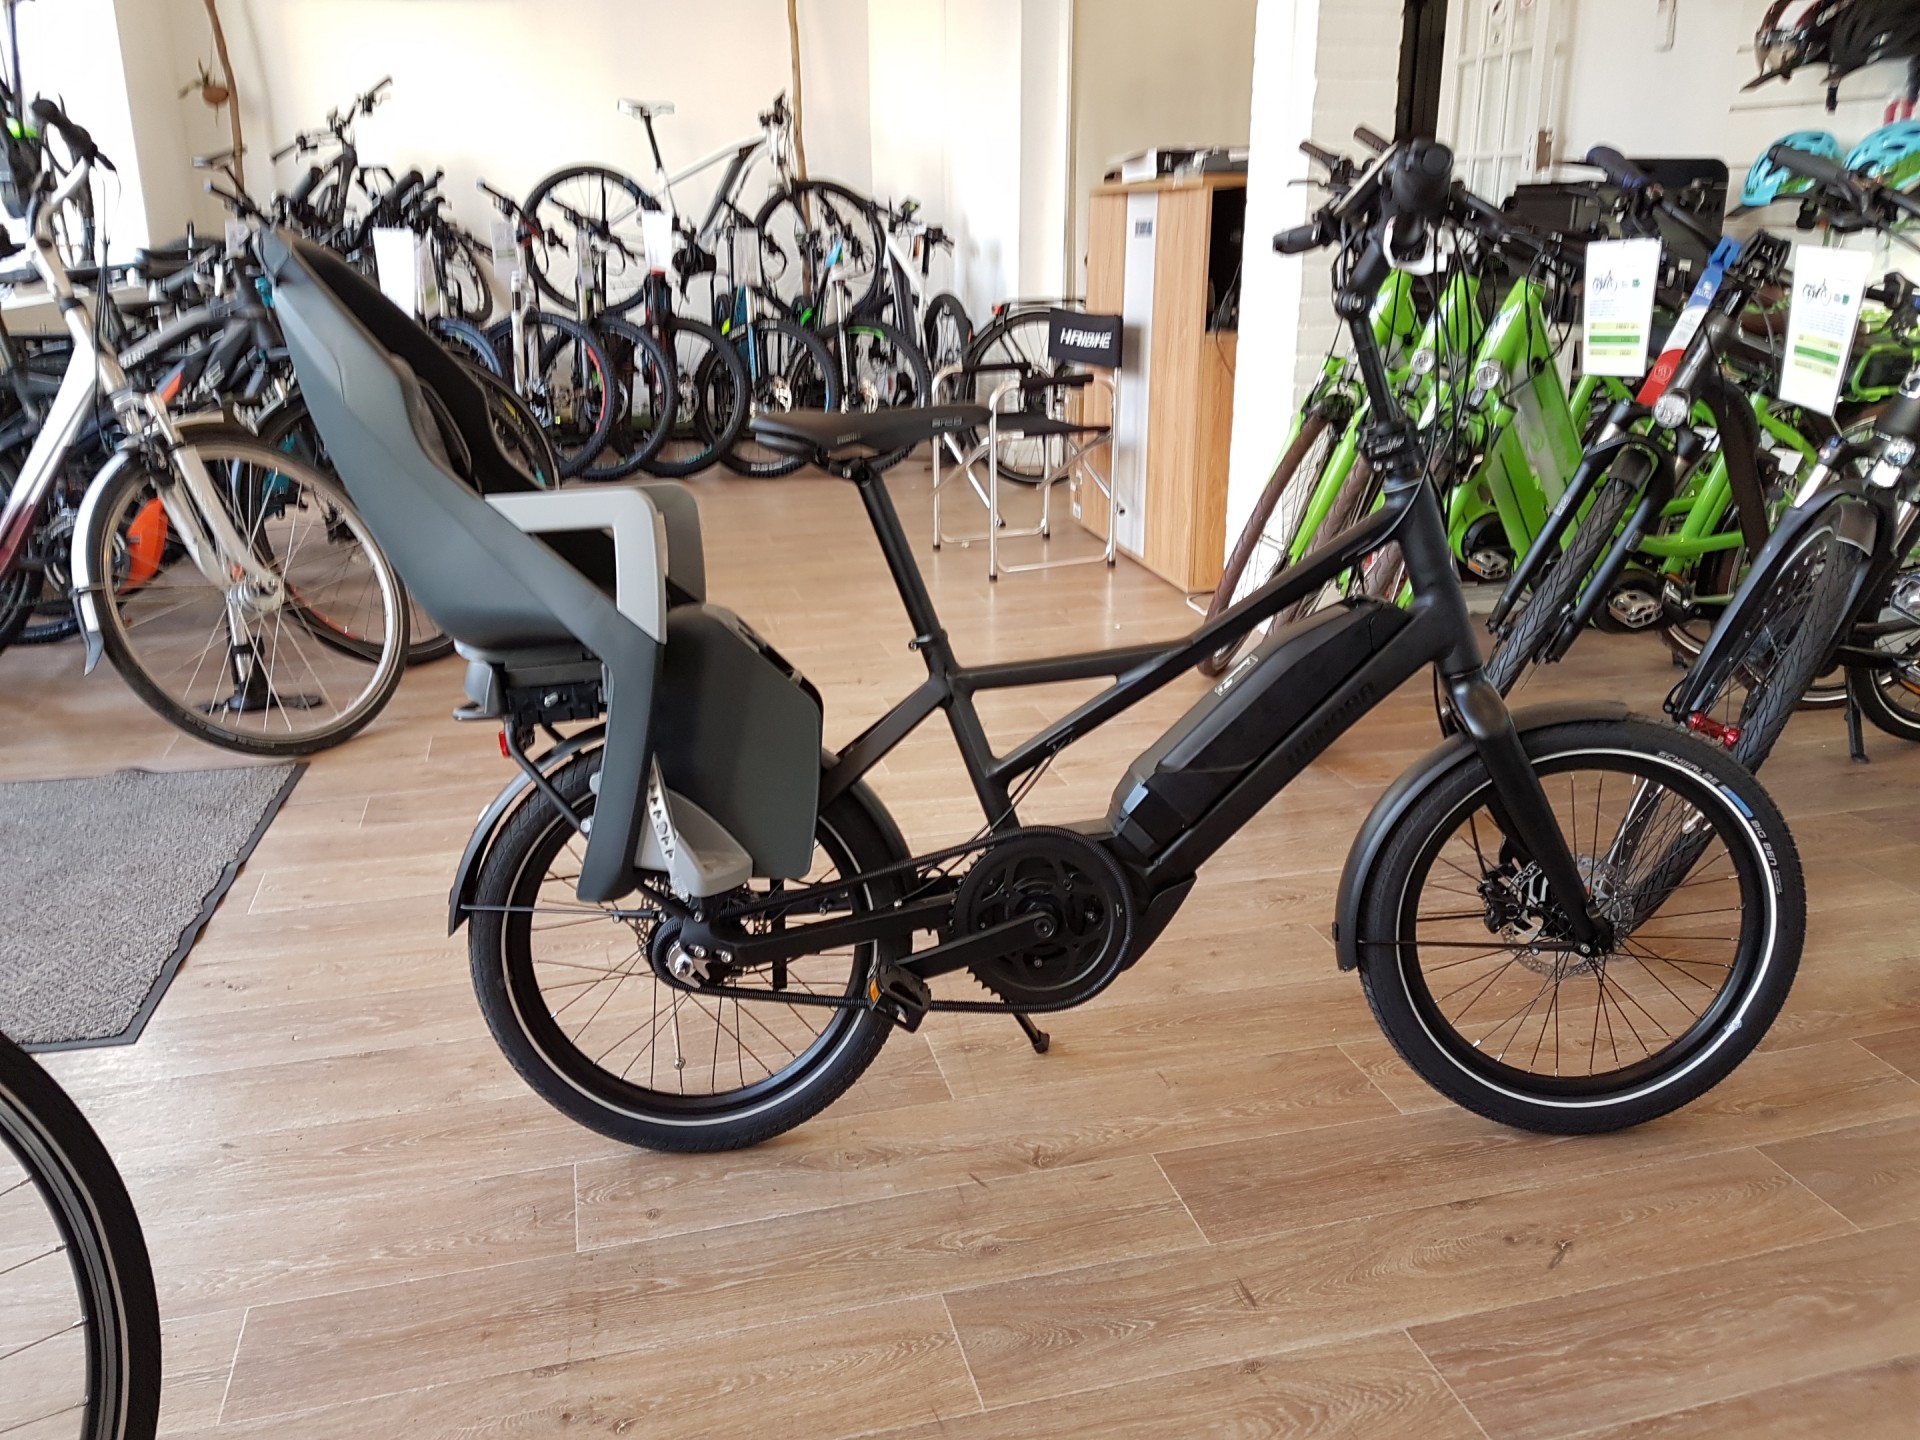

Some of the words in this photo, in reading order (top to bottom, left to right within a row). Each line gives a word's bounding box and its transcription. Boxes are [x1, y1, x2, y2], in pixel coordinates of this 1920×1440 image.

[1060, 327, 1112, 349] HAIBIKE
[1656, 751, 1720, 785] SCHWALBE
[1750, 820, 1767, 839] BIG
[1763, 842, 1778, 867] BEN
